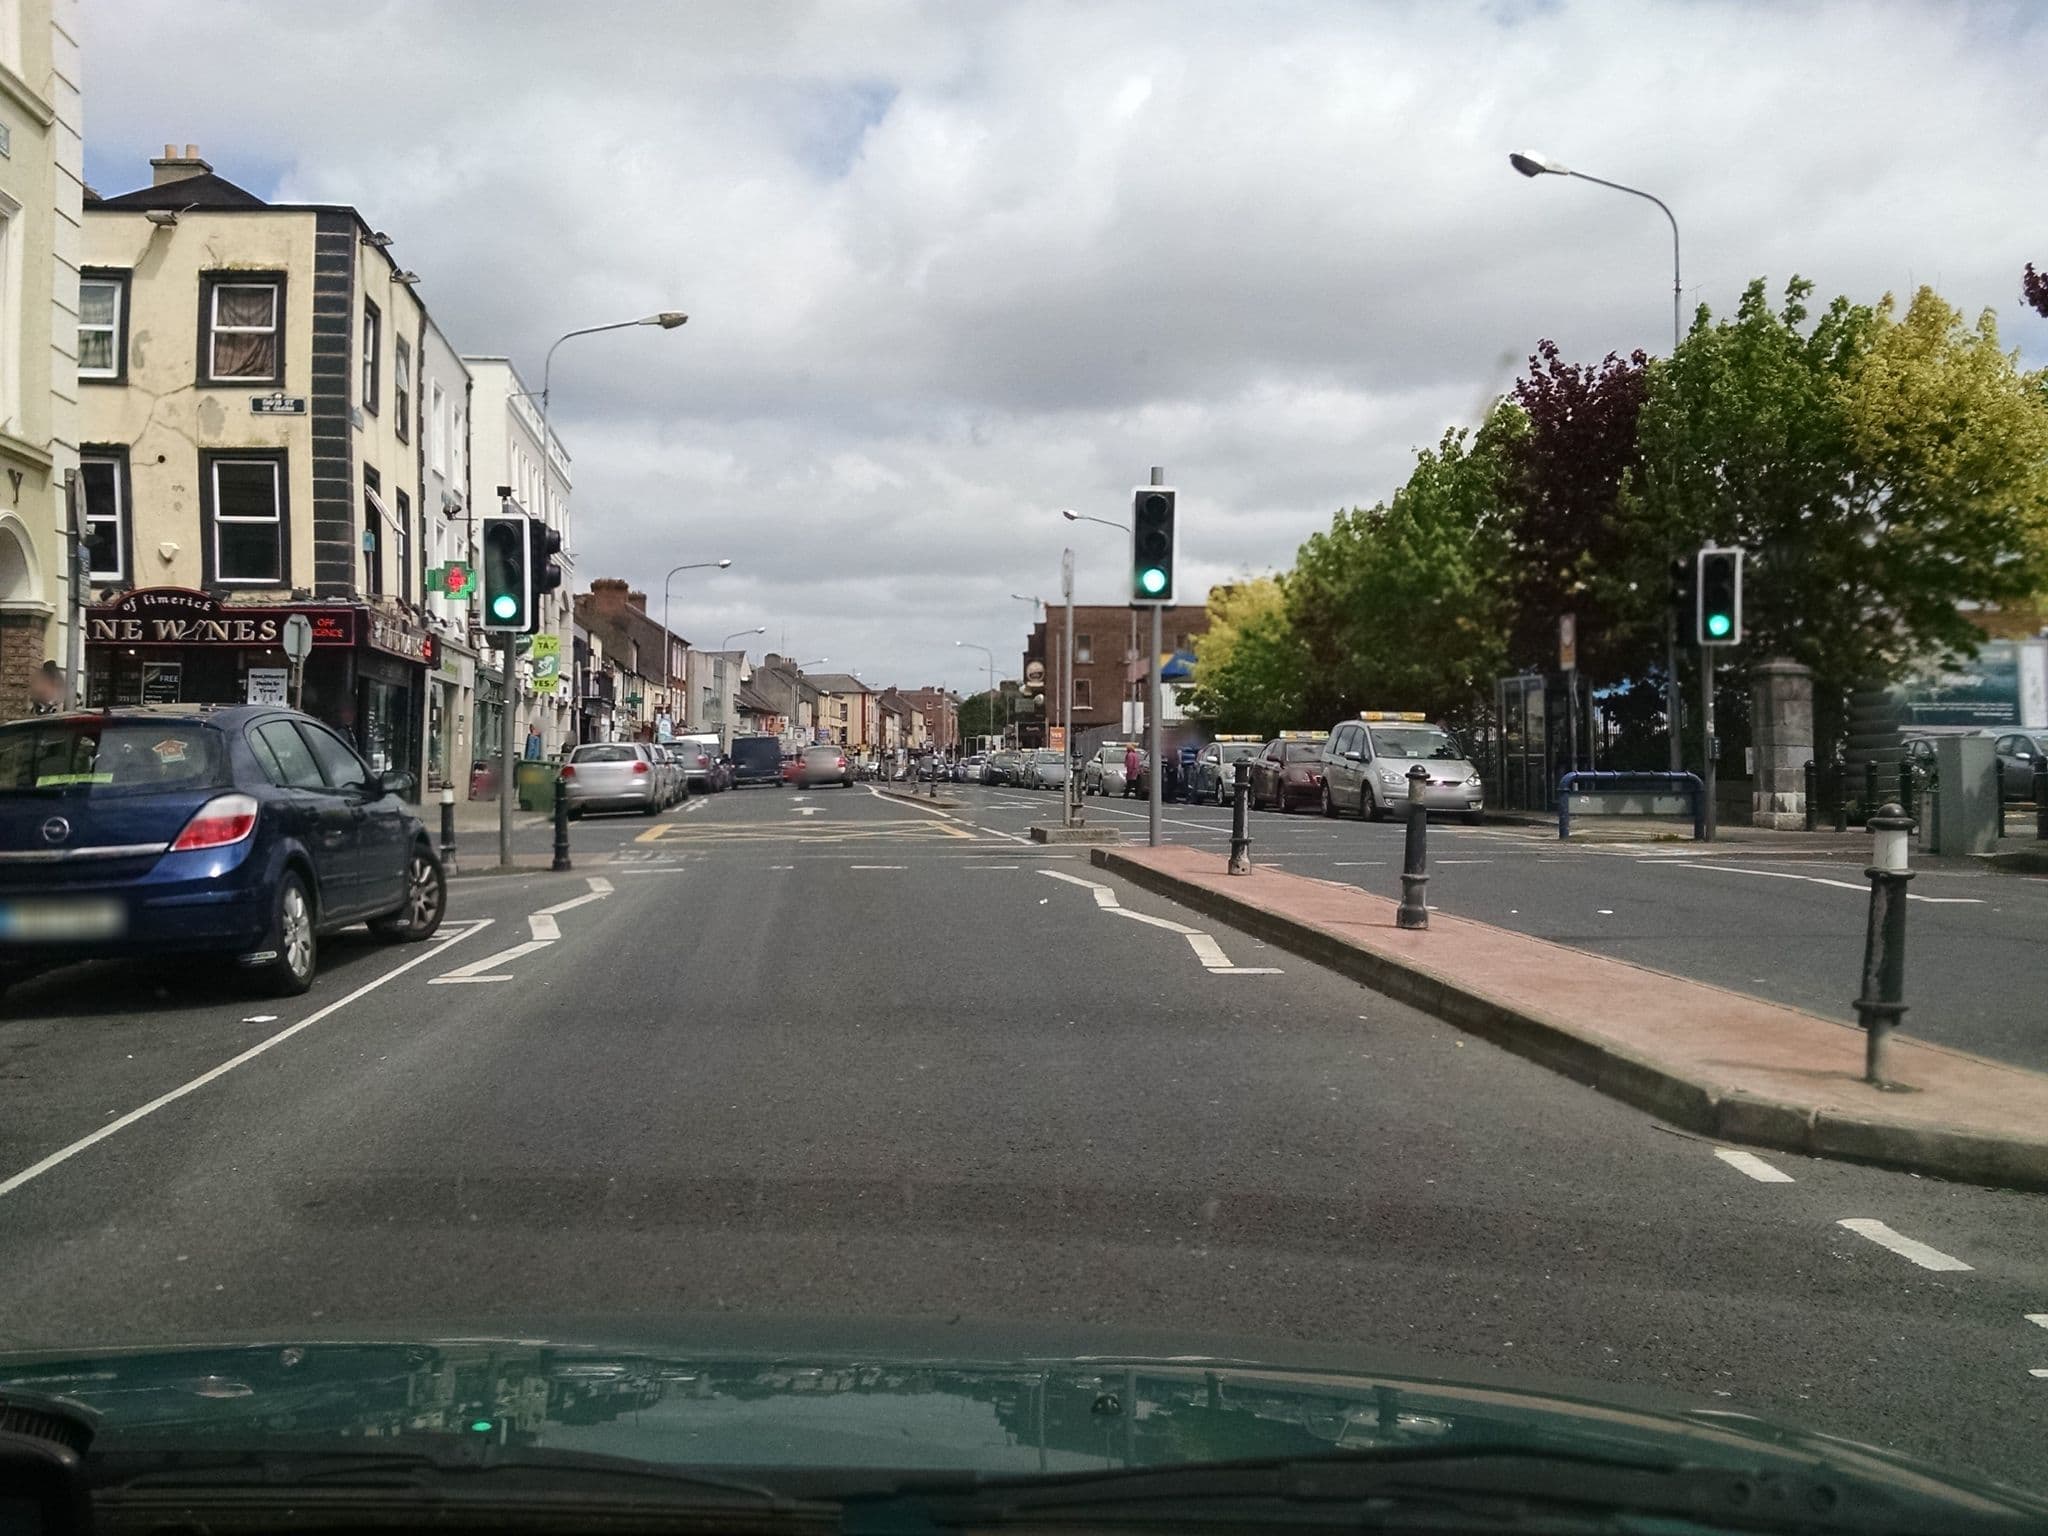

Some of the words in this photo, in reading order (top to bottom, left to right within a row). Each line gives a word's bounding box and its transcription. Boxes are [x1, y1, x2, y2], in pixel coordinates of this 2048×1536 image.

[123, 597, 136, 612] of
[316, 618, 336, 627] OFF
[85, 619, 143, 640] NE
[159, 674, 179, 682] FREE
